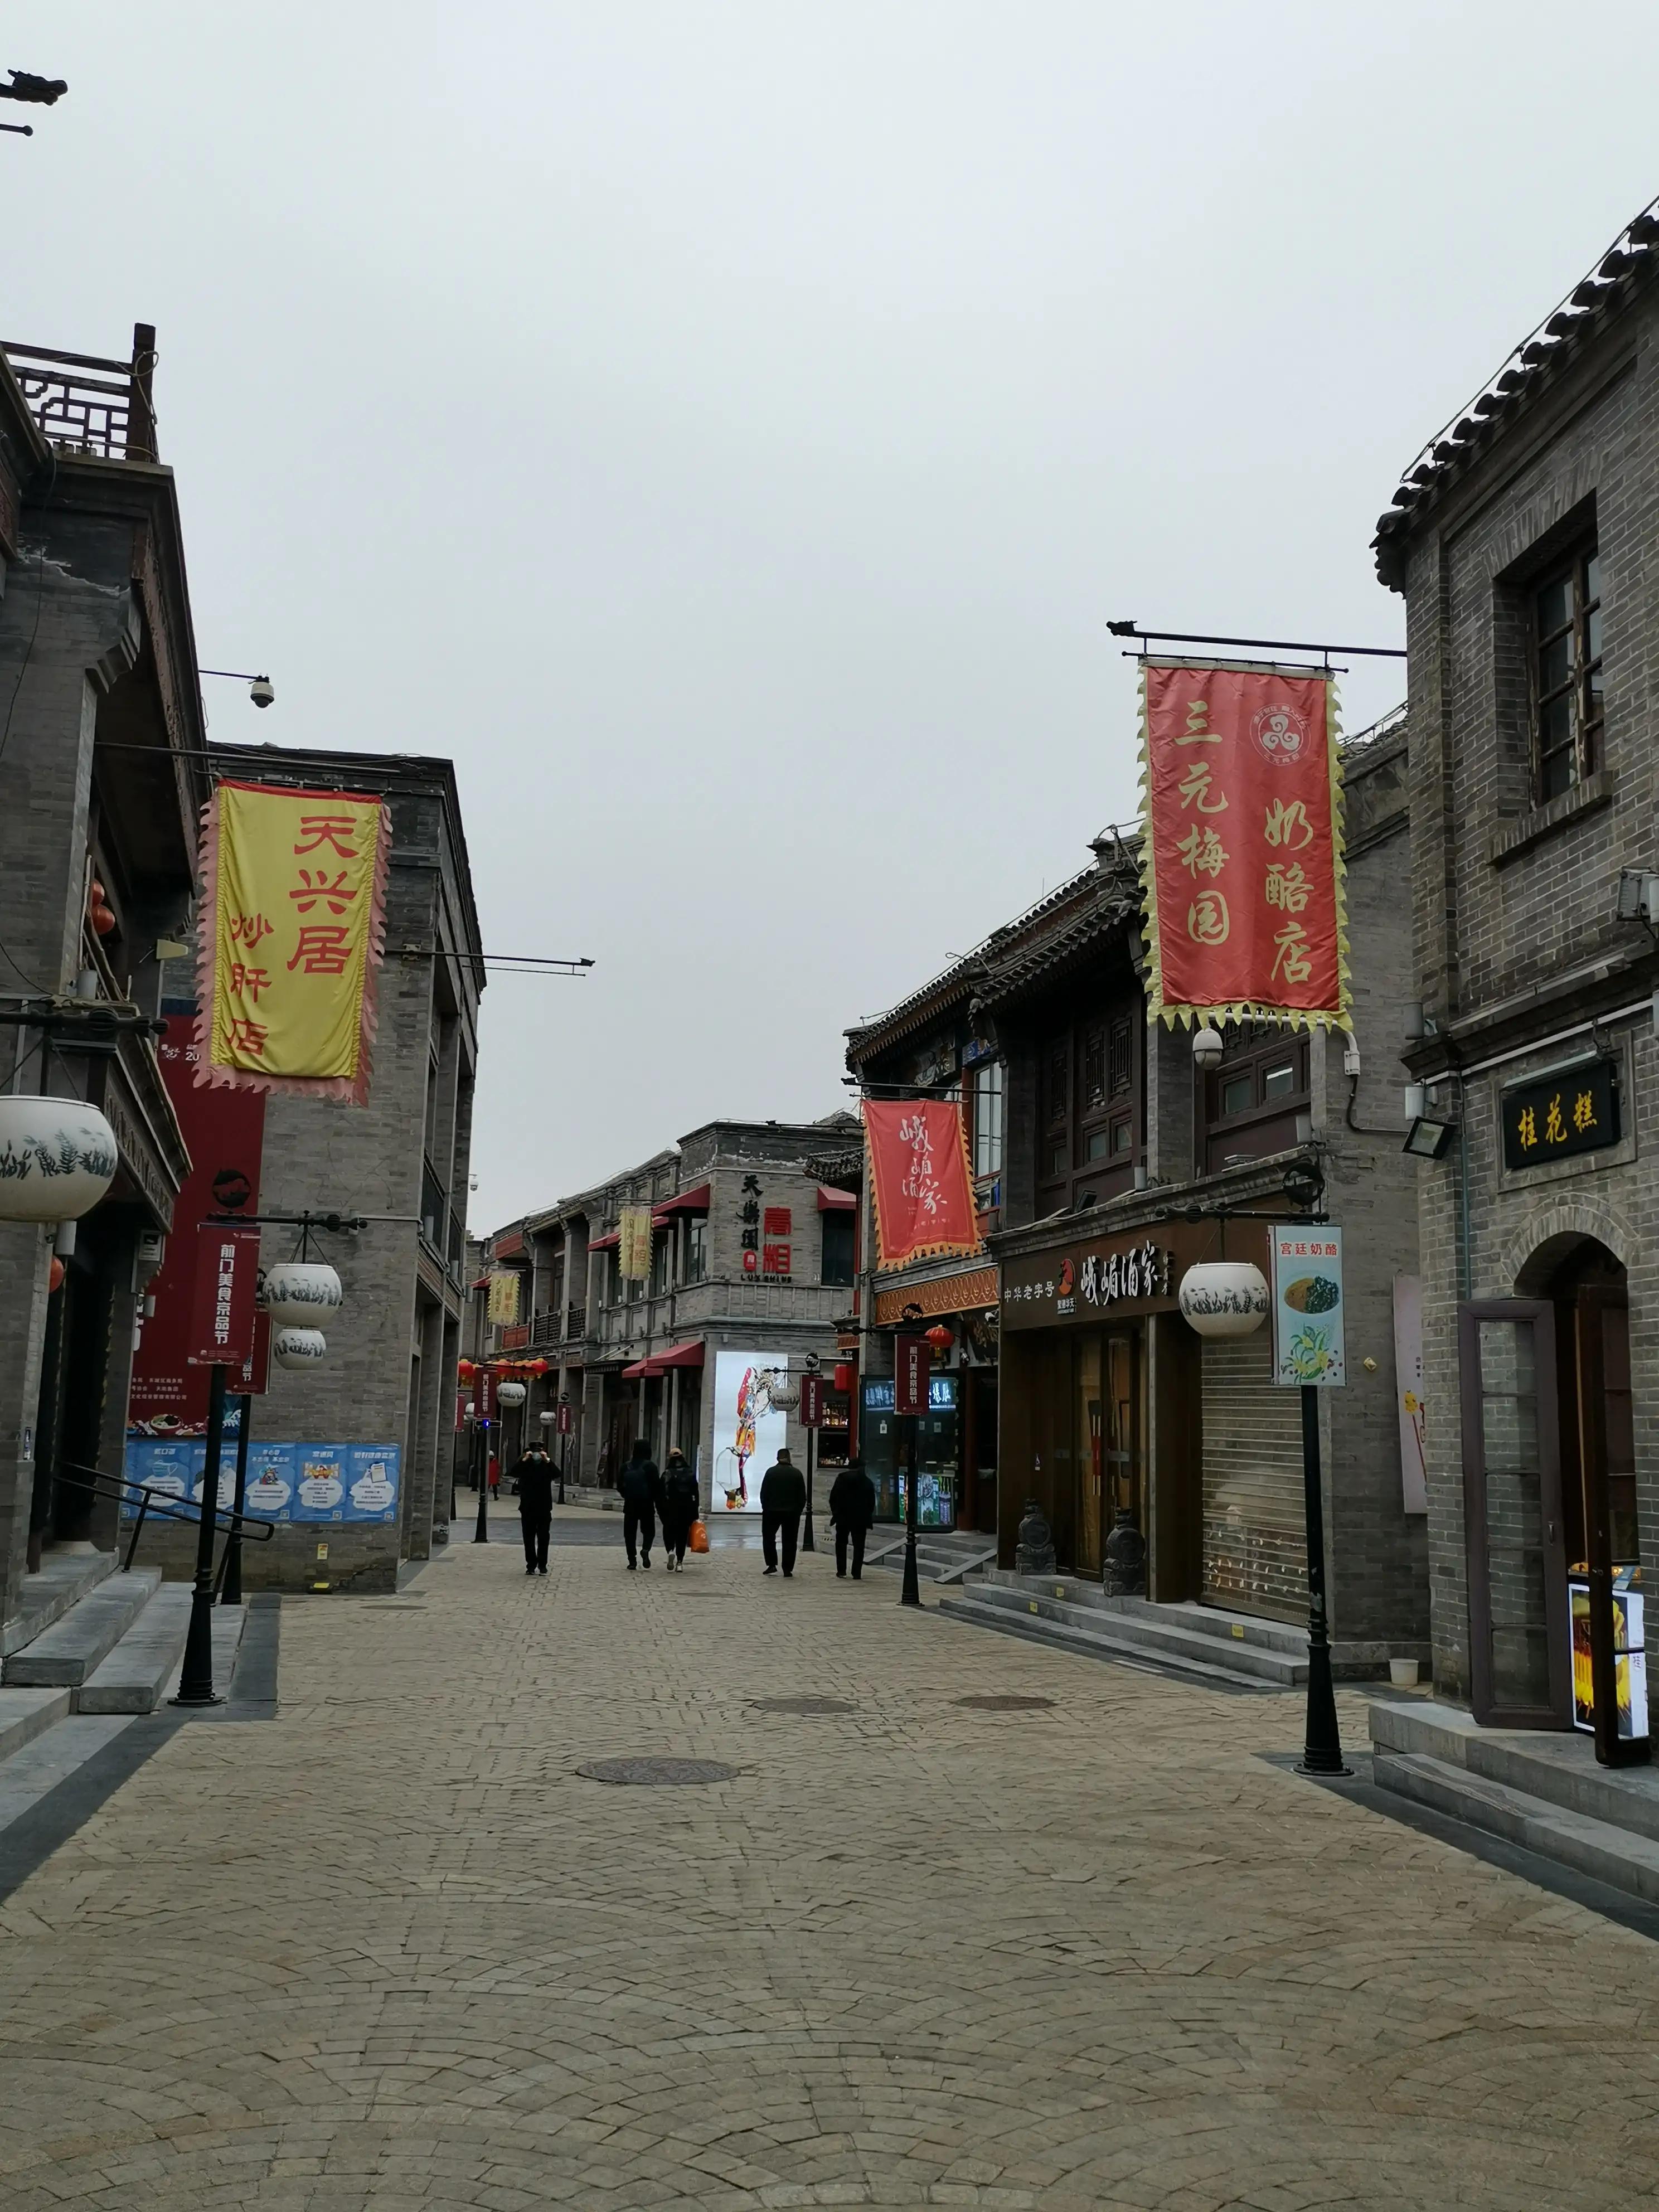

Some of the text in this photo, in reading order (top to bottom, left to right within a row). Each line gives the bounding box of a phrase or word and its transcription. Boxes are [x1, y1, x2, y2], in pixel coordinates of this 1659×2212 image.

[1174, 700, 1230, 945] 三元梅园
[287, 816, 360, 974] 天兴居
[1264, 797, 1314, 984] 奶酪店
[229, 913, 274, 1056] 炒肝店
[1517, 1090, 1598, 1152] 桂花糕
[214, 1244, 236, 1345] 前门美食京品节
[1004, 1280, 1055, 1303] 中华老字号
[1280, 1241, 1338, 1257] 宫廷奶酪
